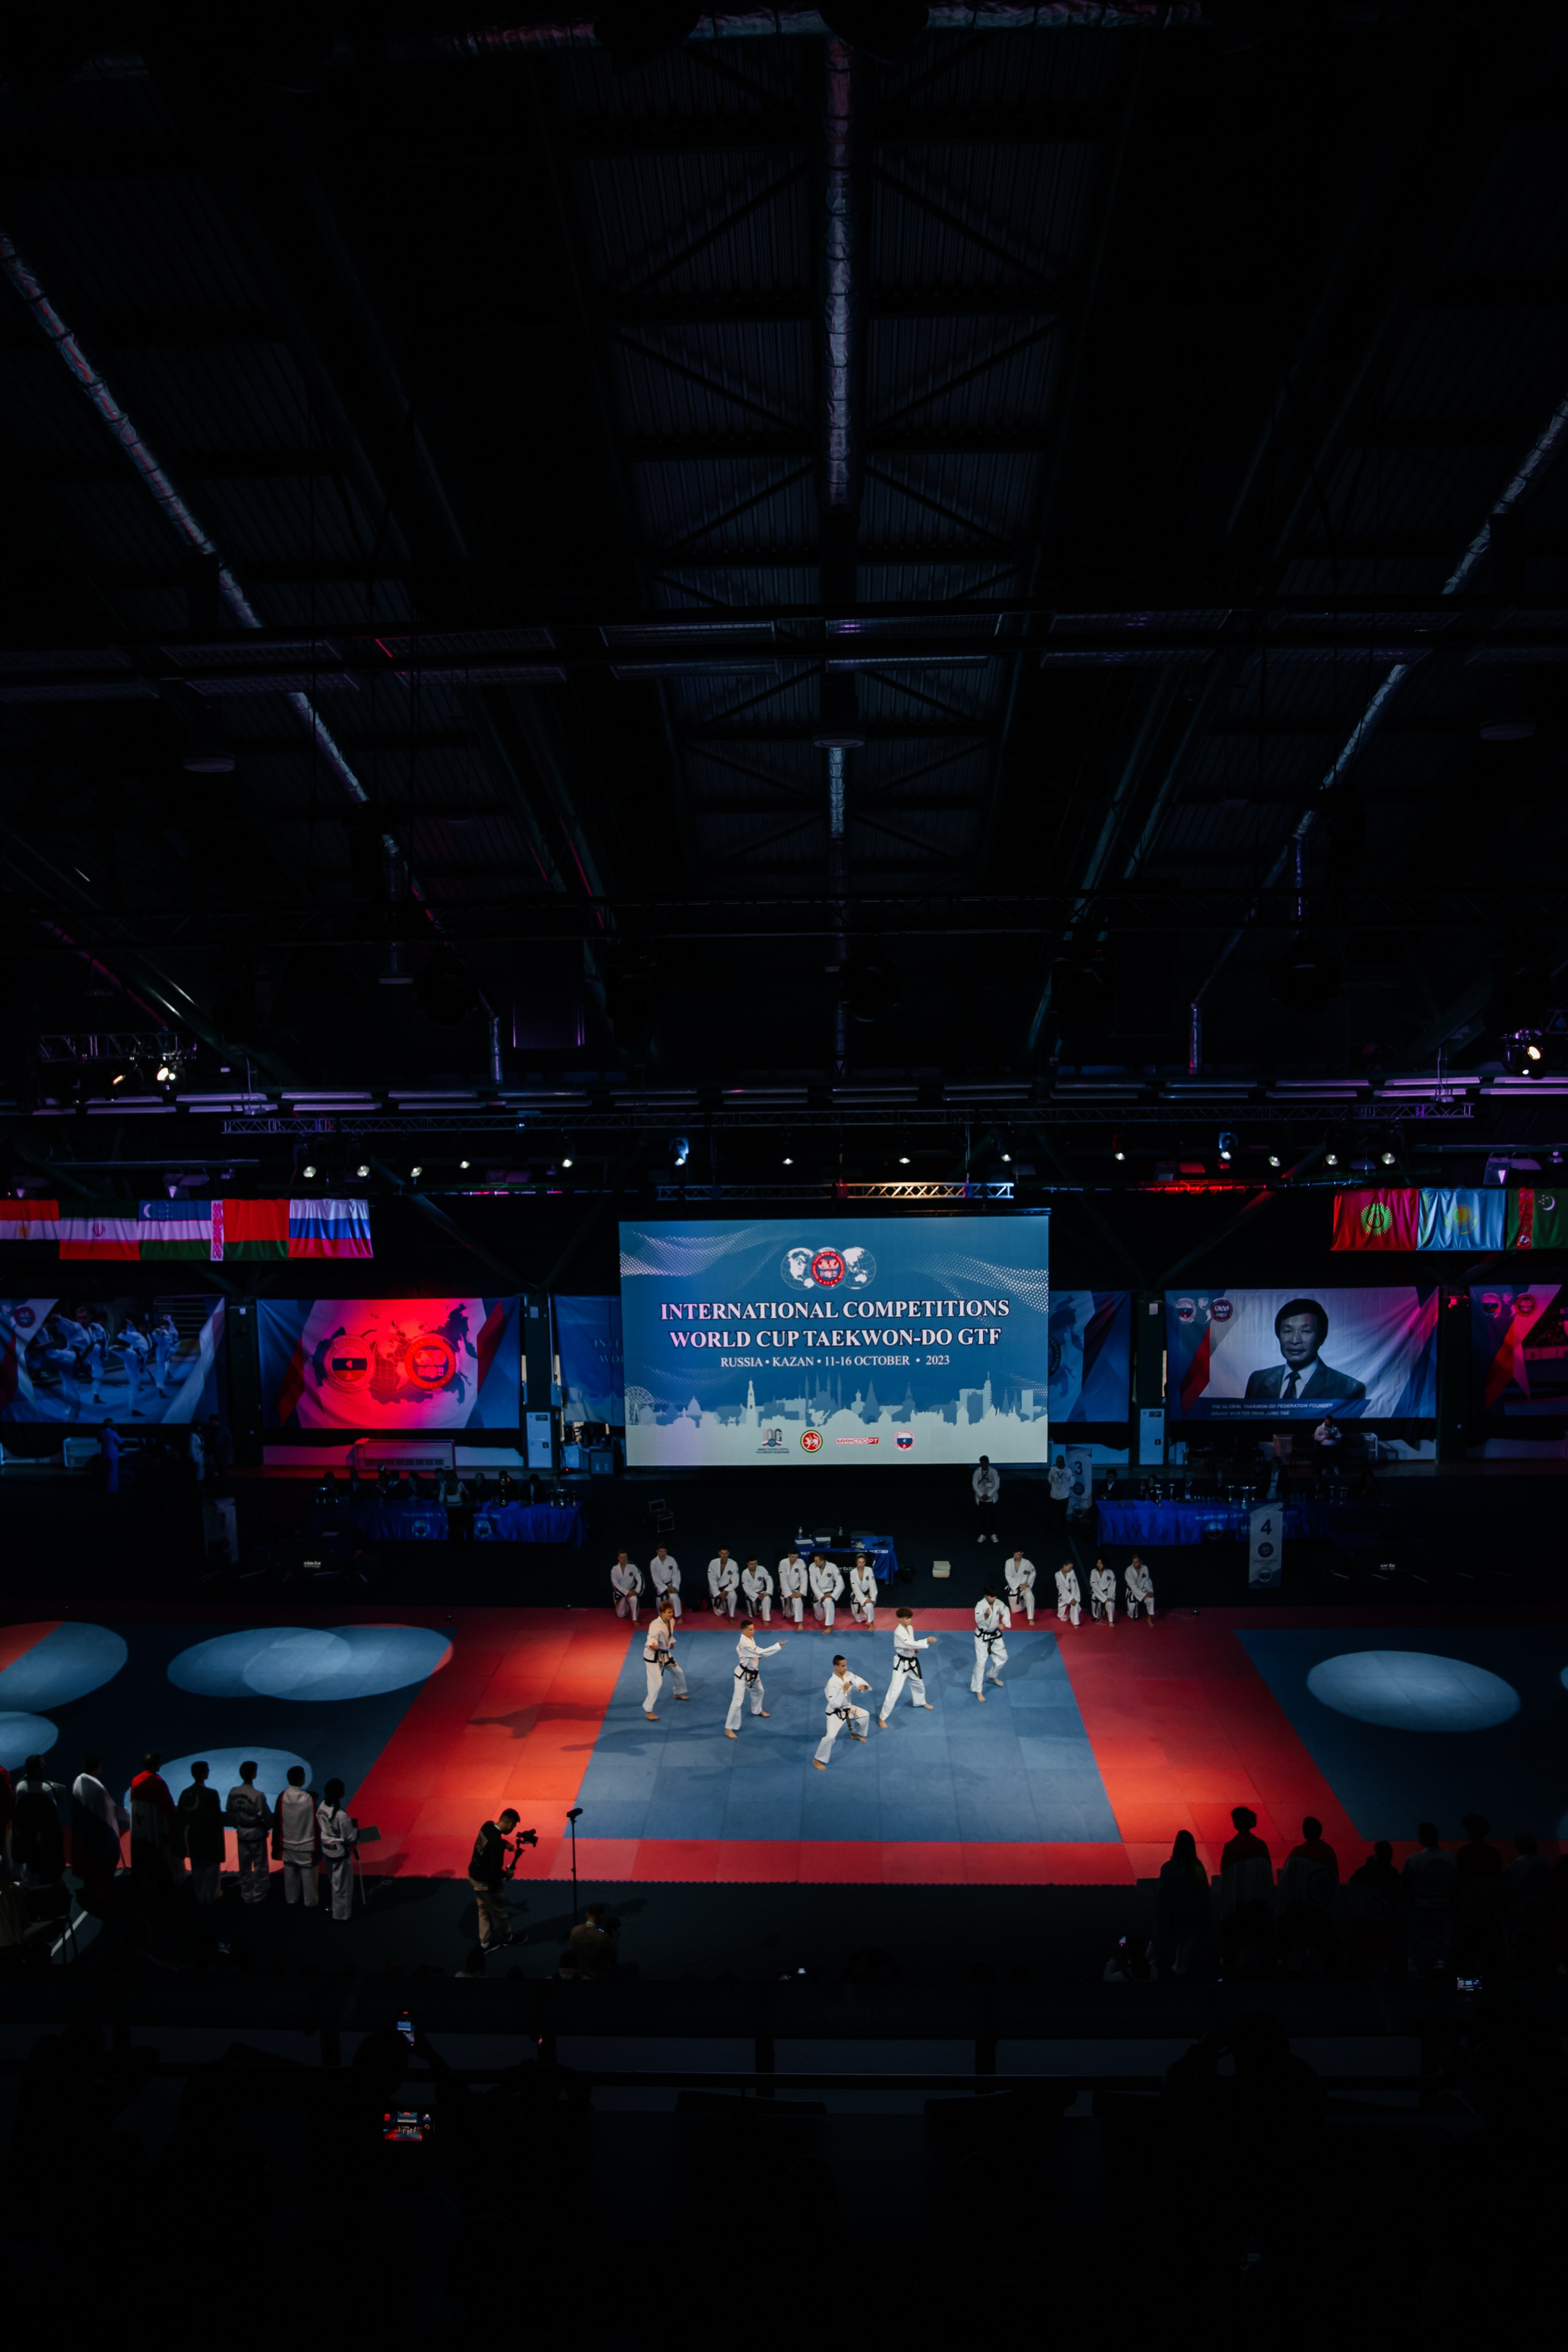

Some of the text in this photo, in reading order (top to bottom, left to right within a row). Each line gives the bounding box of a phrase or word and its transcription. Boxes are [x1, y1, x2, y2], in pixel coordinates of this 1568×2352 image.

[660, 1299, 1010, 1320] INTERNATIONAL COMPETITIONS
[669, 1327, 1002, 1348] WORLD CUP TAEKWON-DO GTF
[721, 1355, 950, 1368] RUSSIA KAZAN 11-16 OCTOBER 2023
[1074, 1460, 1083, 1476] 3
[1260, 1518, 1272, 1535] 4
